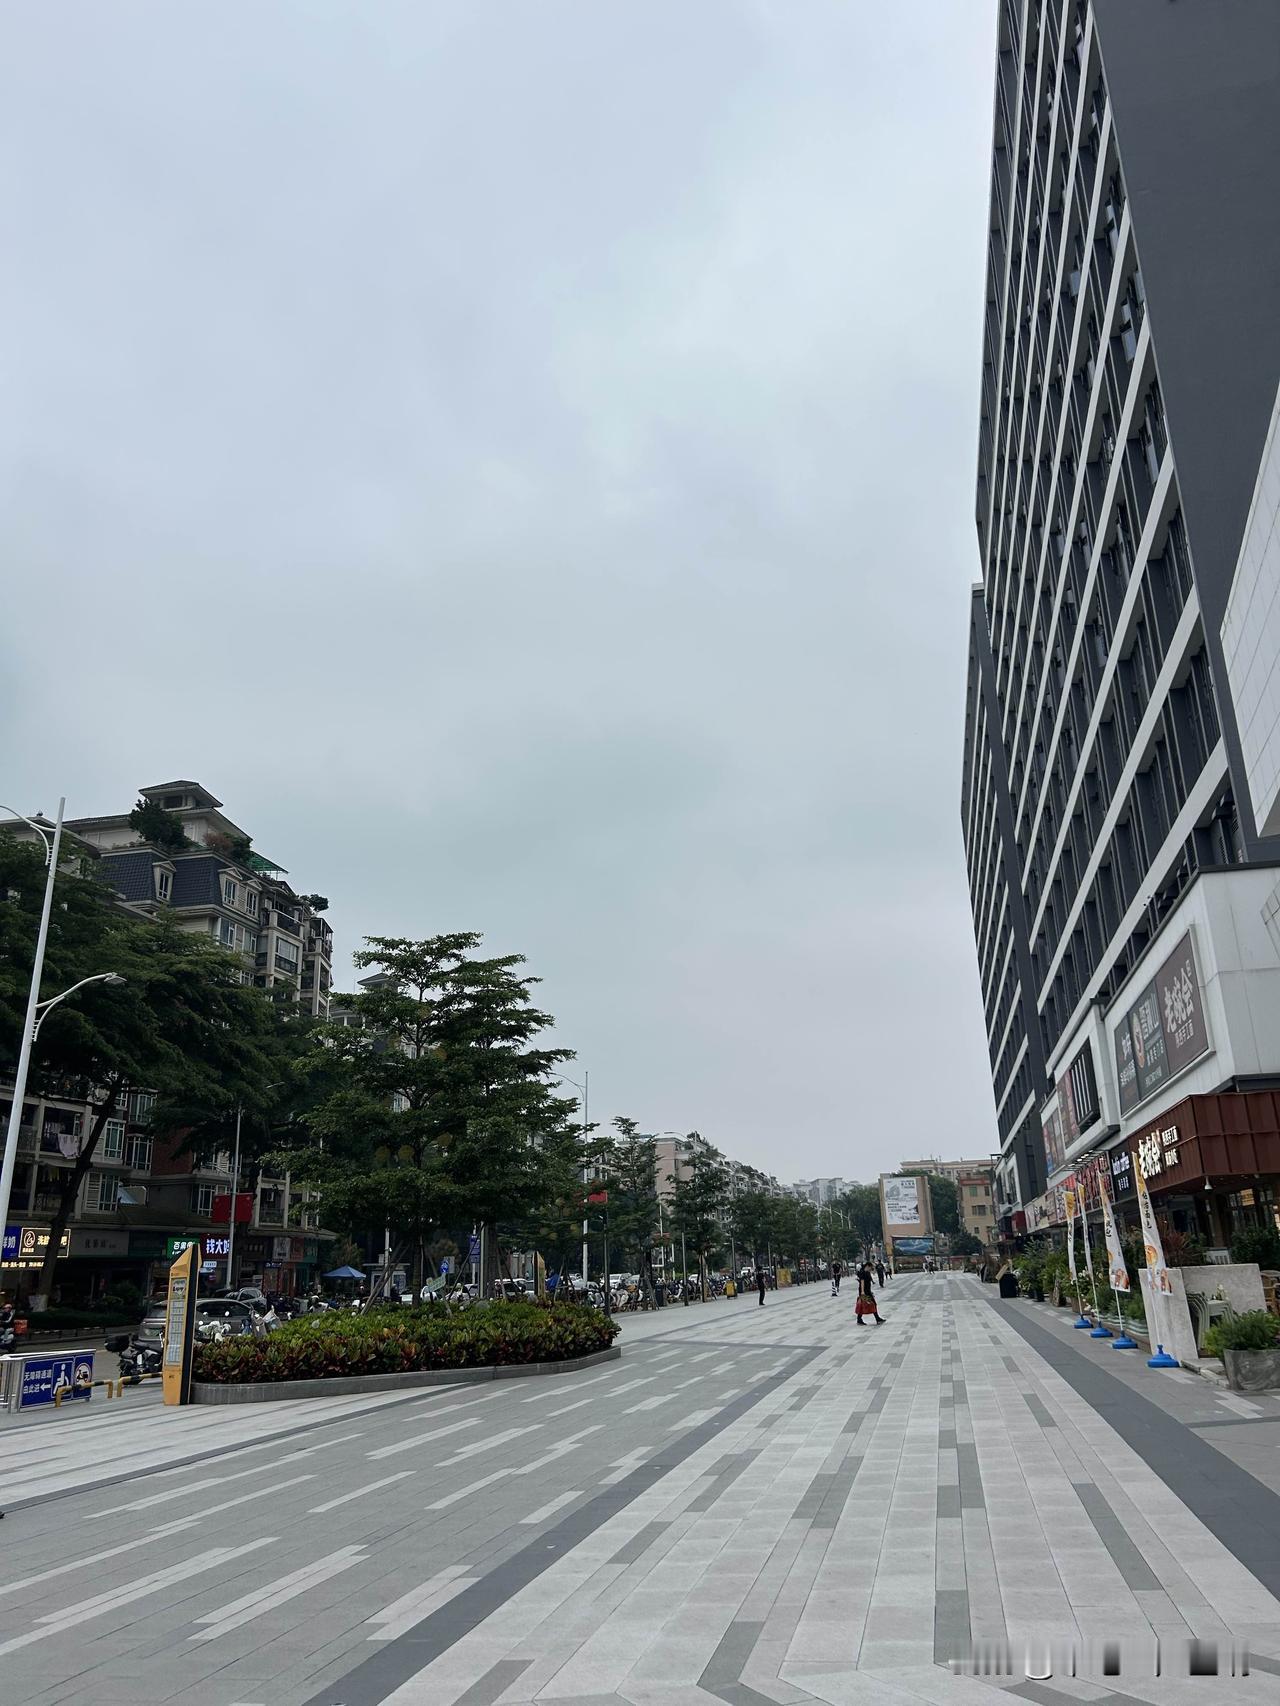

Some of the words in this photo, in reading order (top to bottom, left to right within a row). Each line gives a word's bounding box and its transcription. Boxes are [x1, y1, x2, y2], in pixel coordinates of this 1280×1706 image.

[1164, 967, 1194, 1033] 老碗会
[24, 1369, 52, 1381] 无障碍通道
